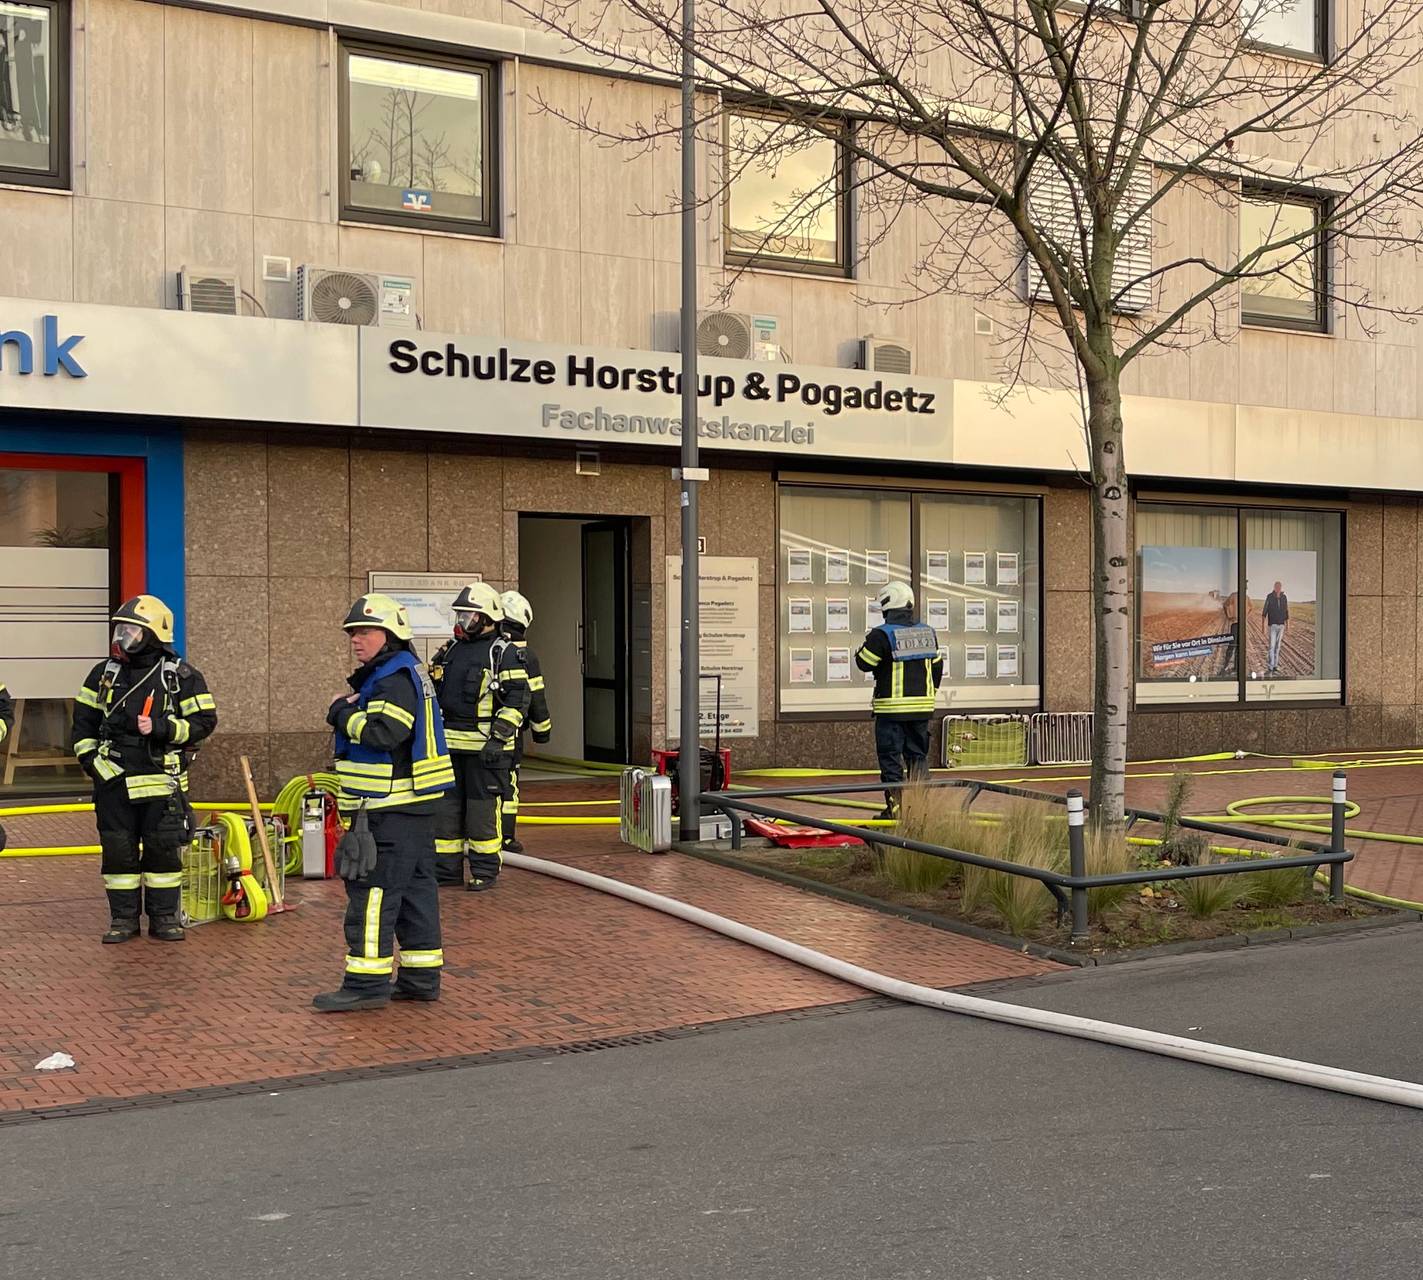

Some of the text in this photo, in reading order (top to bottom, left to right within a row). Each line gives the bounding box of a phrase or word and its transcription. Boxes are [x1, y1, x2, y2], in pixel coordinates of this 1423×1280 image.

[389, 339, 936, 416] Schulze Horstup & Pogadetz
[542, 402, 815, 445] Fachanwatskanzlei
[1172, 642, 1181, 650] Sie
[1191, 639, 1201, 647] Ort
[707, 712, 730, 721] Etge
